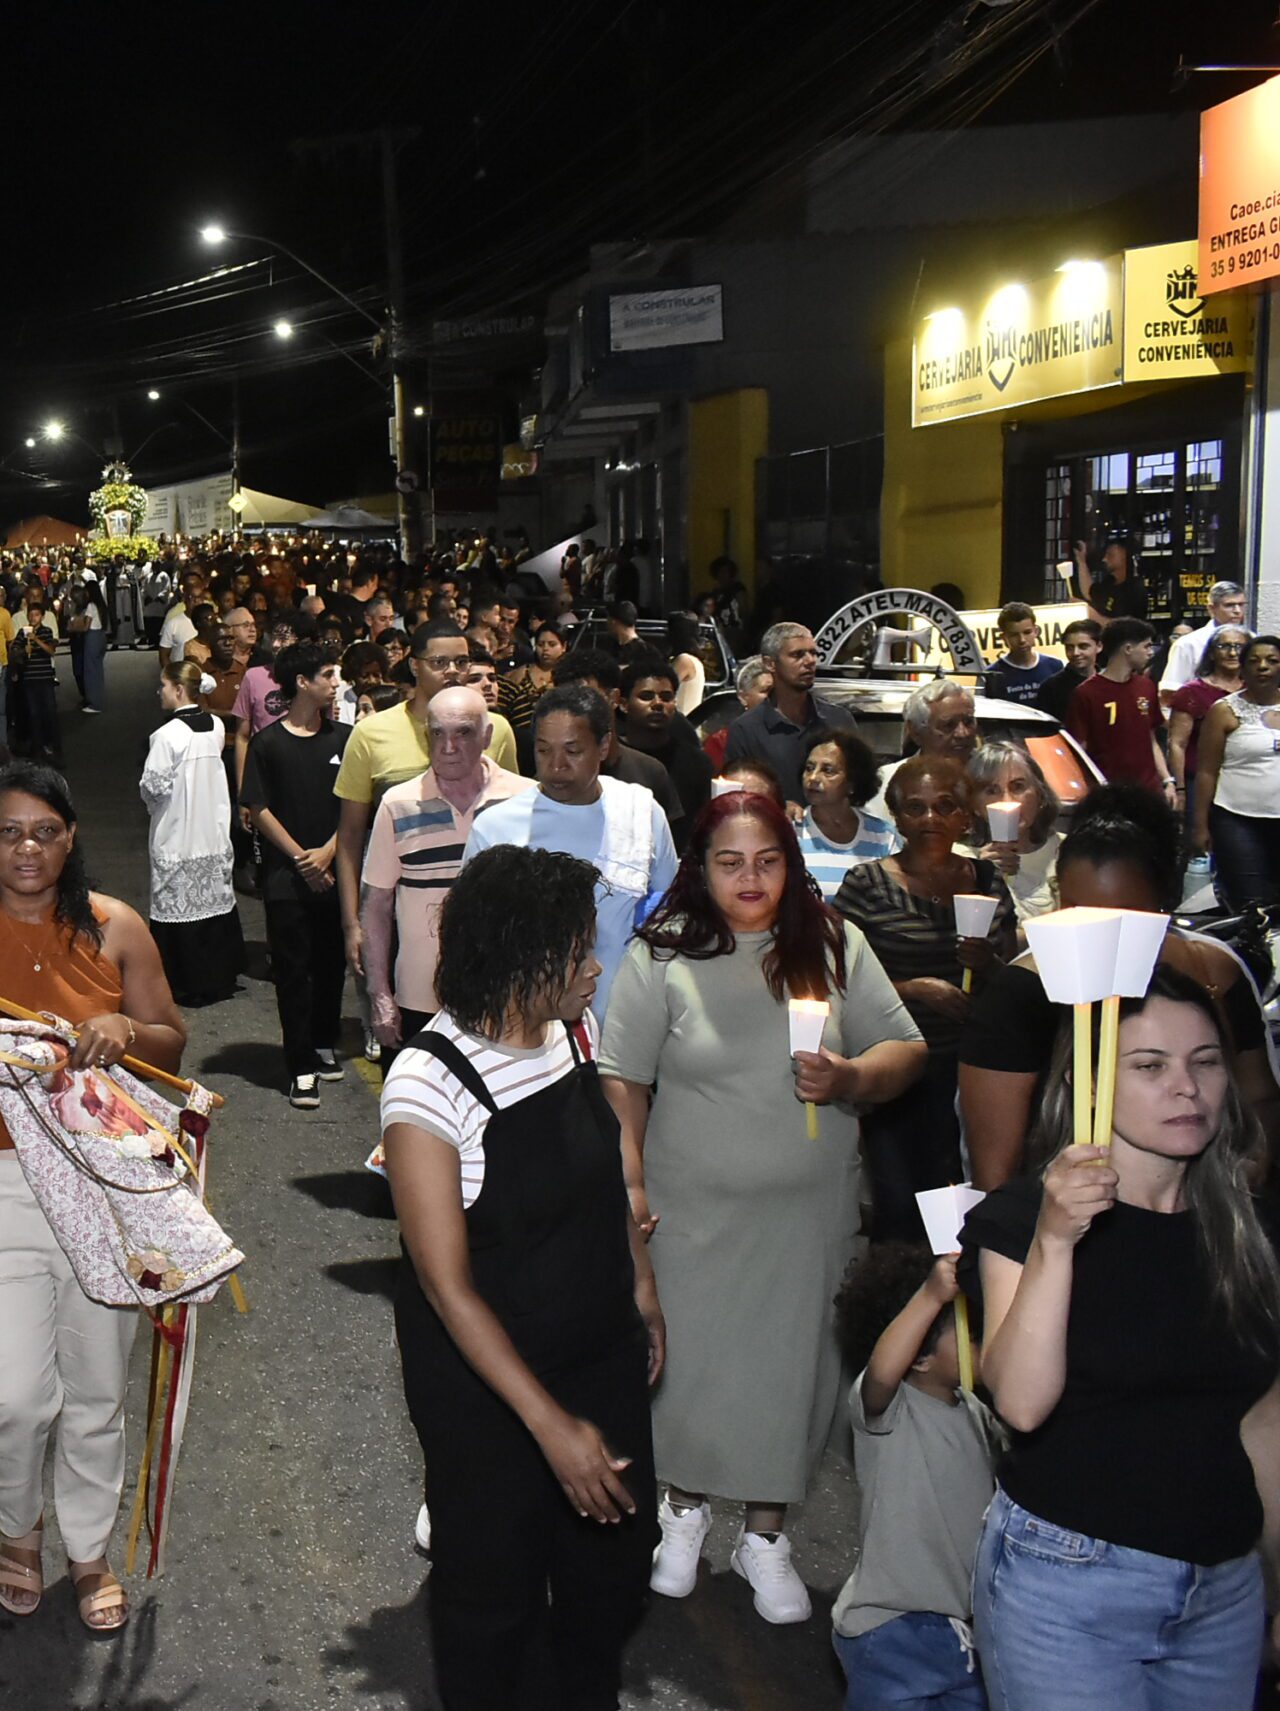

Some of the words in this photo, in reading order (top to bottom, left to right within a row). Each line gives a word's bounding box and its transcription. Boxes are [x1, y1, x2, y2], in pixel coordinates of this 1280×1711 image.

[1210, 220, 1266, 254] ENTREGA
[1269, 216, 1280, 234] G
[1210, 259, 1225, 278] 35
[1228, 255, 1235, 273] 9
[1144, 317, 1228, 338] CERVEJARIA
[1138, 339, 1234, 363] CONVENIÊNCIA
[919, 345, 983, 392] CERVEJARIA
[436, 419, 494, 440] AUTO
[435, 443, 495, 466] PEÇAS
[1179, 573, 1204, 588] TEMOS
[942, 619, 974, 667] 7834
[1104, 701, 1118, 726] 7
